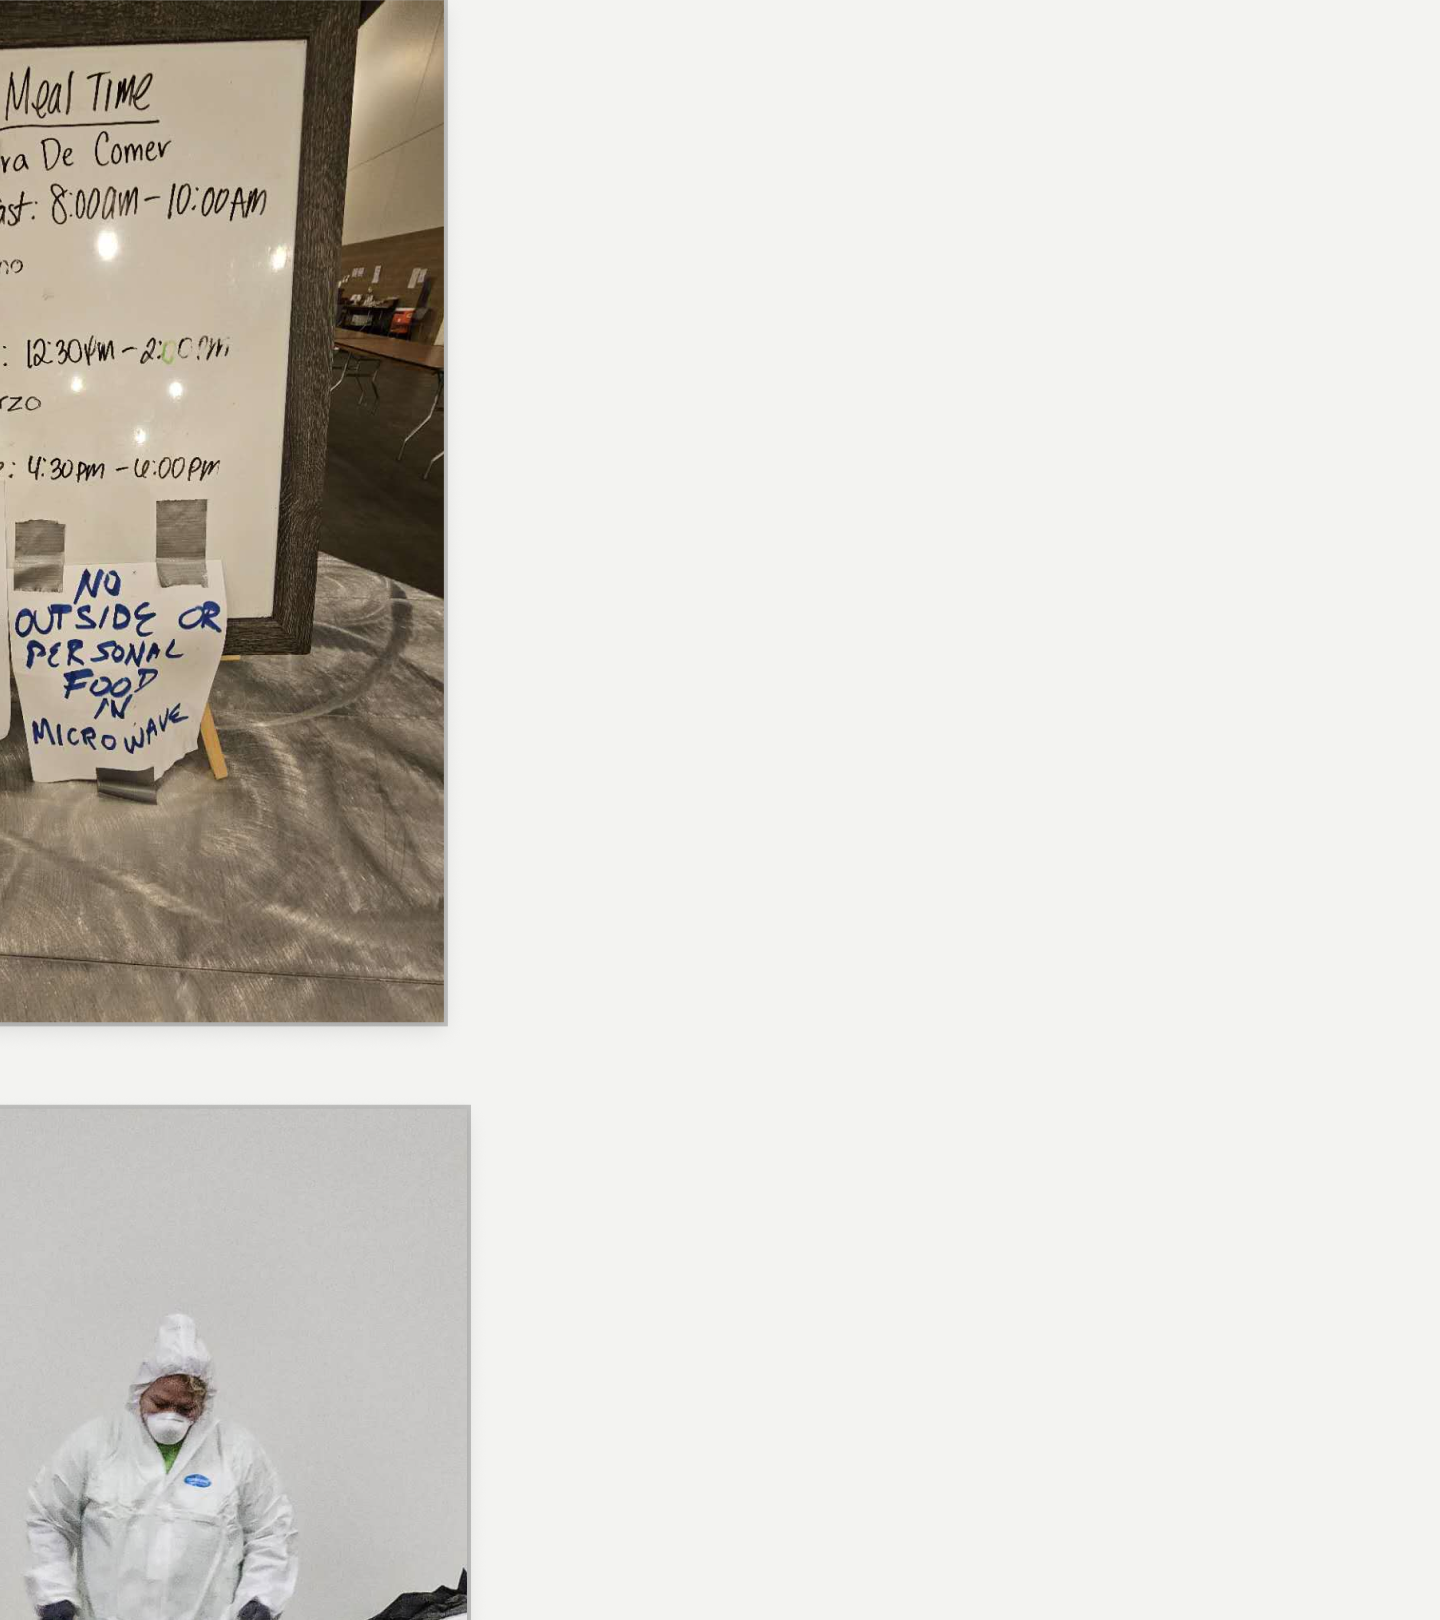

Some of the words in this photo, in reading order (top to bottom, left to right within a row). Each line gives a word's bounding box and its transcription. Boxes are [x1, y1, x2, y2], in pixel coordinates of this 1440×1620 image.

[5, 66, 74, 121] Meal
[41, 137, 74, 170] De
[94, 131, 172, 167] Comer
[73, 568, 122, 605] NO
[14, 601, 157, 638] OUTSIDE
[177, 600, 223, 633] OR
[25, 638, 184, 670] PERSONAL
[63, 667, 159, 699] FOOD
[93, 693, 133, 720] IN
[31, 702, 189, 755] MICROWAVE
